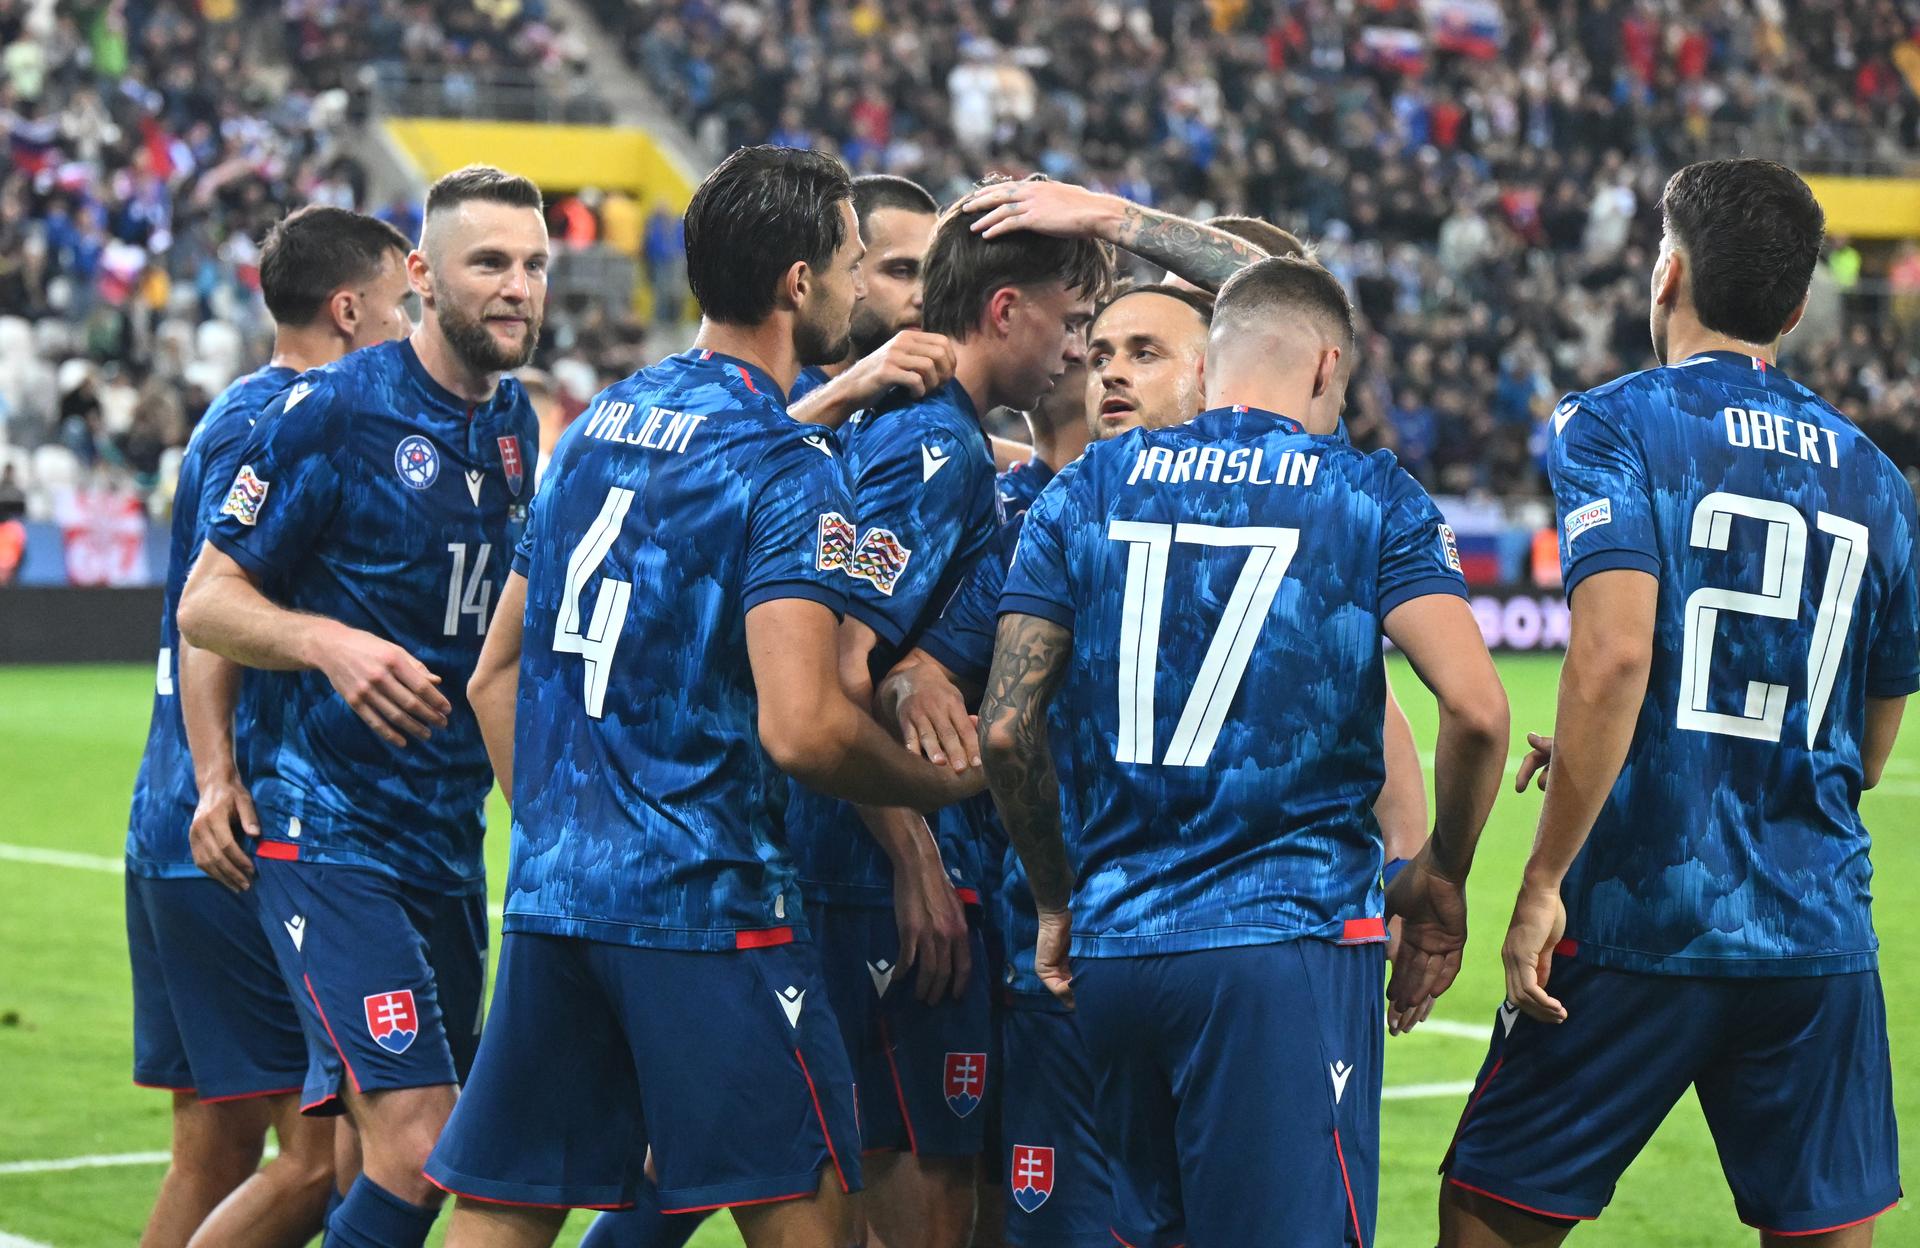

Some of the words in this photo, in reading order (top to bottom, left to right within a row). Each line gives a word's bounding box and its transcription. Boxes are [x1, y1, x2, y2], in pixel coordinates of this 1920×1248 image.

[584, 400, 708, 454] VALJENT
[1723, 407, 1839, 469] OBERT
[443, 543, 493, 636] 14
[552, 486, 636, 719] 4
[1108, 520, 1300, 767] 17
[1676, 492, 1869, 752] 21
